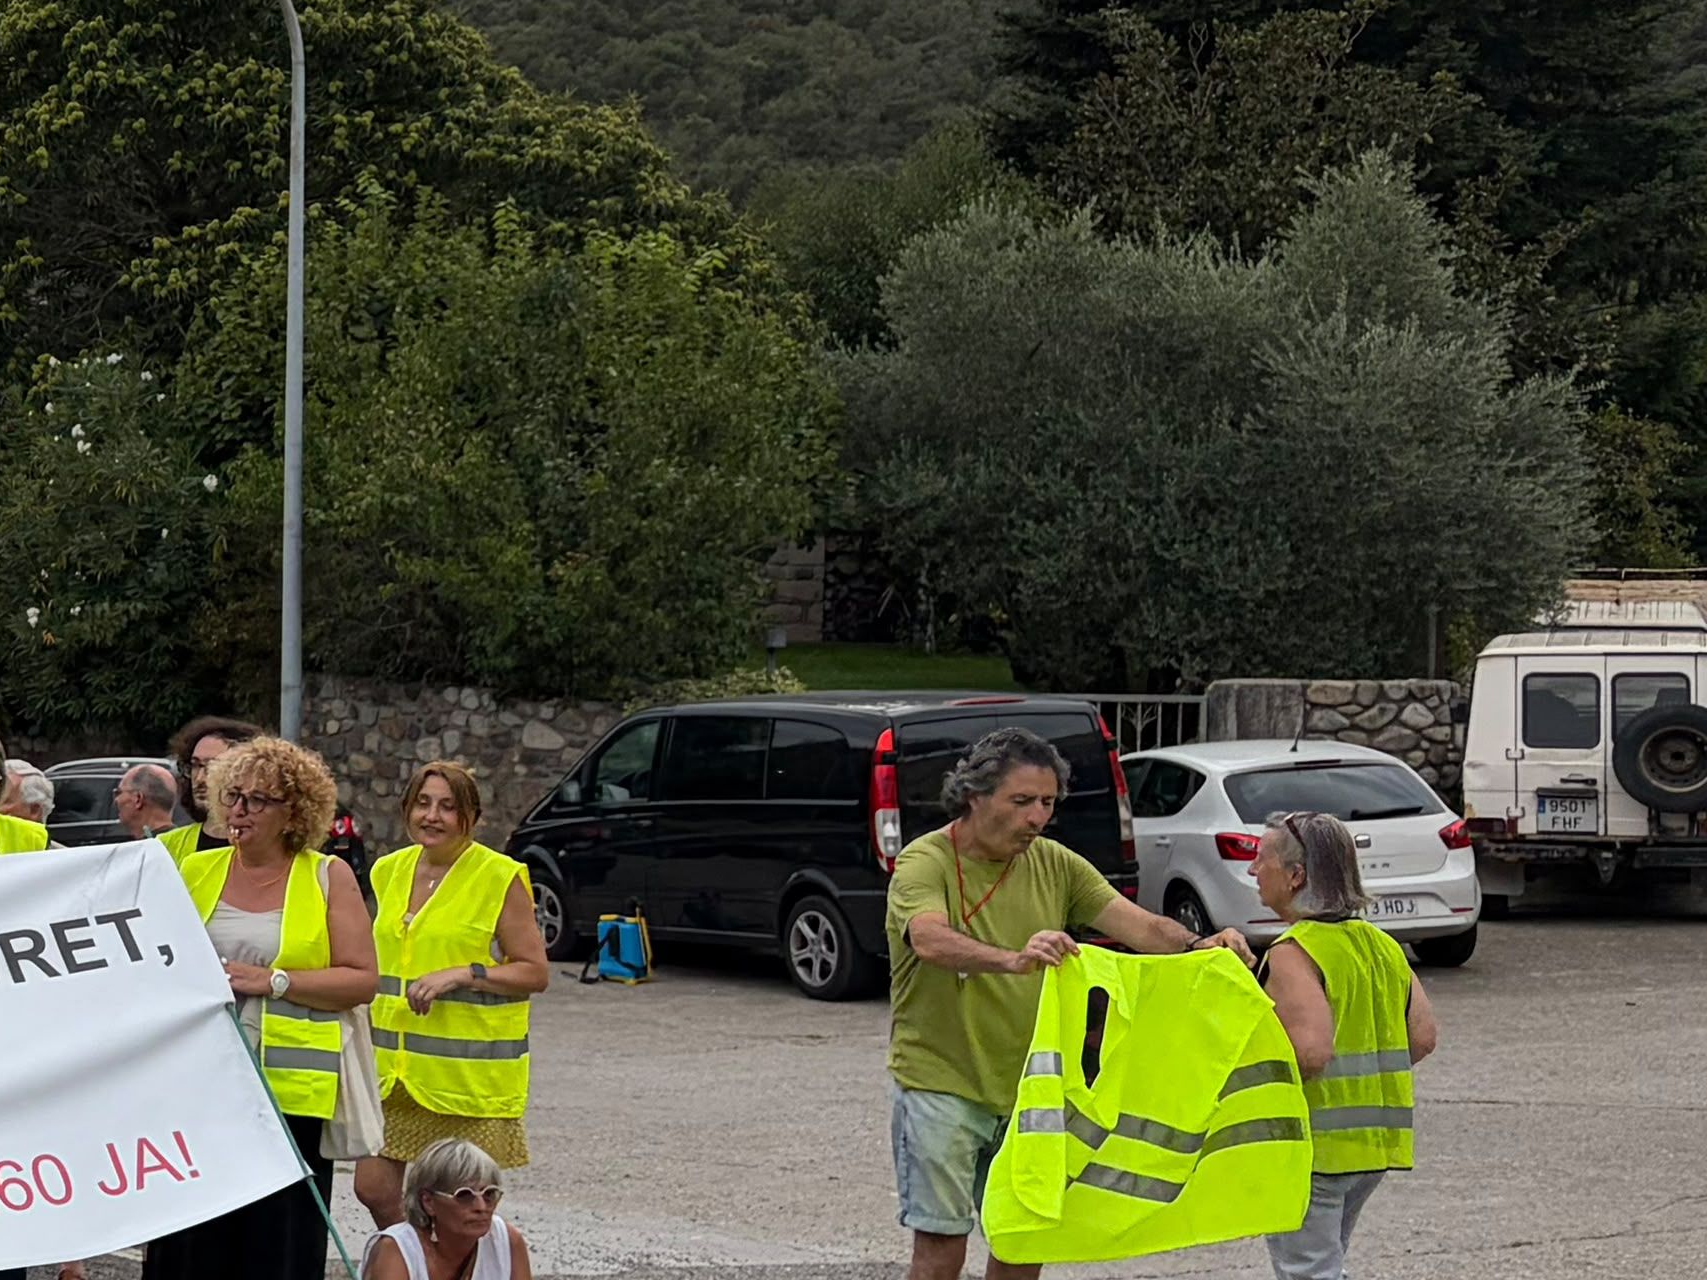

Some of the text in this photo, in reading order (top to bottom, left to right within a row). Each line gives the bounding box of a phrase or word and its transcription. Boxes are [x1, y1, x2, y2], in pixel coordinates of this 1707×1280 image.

[1549, 800, 1586, 814] 9501
[1551, 816, 1583, 830] FHF
[1384, 899, 1415, 915] HDJ
[97, 1129, 202, 1198] JA!
